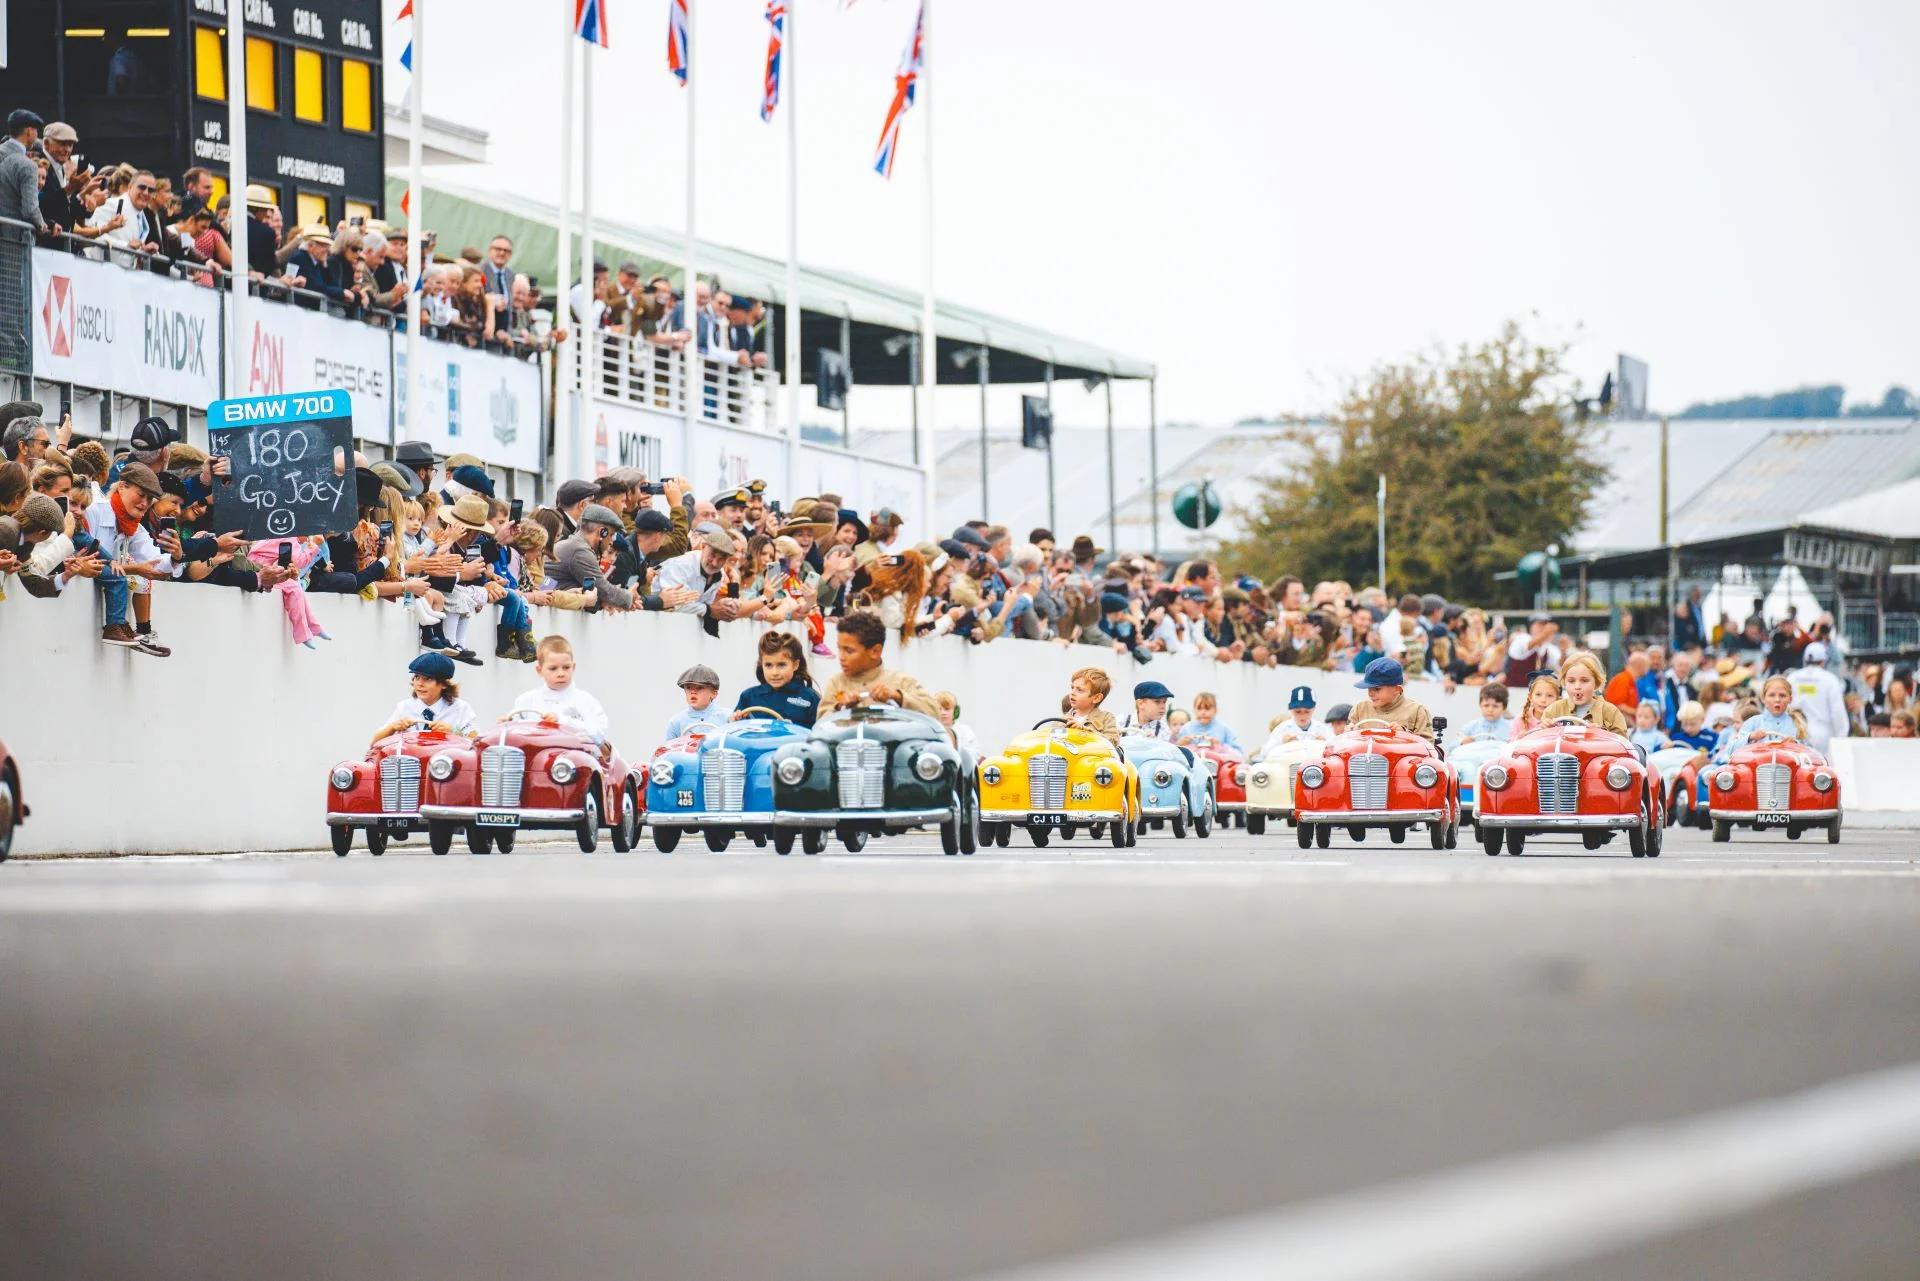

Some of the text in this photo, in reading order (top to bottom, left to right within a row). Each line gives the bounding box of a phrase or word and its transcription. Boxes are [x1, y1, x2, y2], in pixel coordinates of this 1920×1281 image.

[293, 8, 311, 36] CAR
[341, 19, 358, 47] CAR
[204, 121, 222, 140] LAPS
[277, 155, 295, 177] LAPS
[319, 164, 345, 186] LEADER
[77, 304, 101, 342] HSBC
[145, 304, 205, 376] RANDOX
[250, 320, 284, 395] AON
[224, 396, 334, 421] BMW 700
[248, 428, 308, 467] 180
[677, 790, 693, 799] TVC
[677, 798, 694, 807] 405
[480, 814, 517, 824] WOSPY
[1033, 815, 1045, 823] CJ
[1049, 815, 1061, 823] 18
[1757, 814, 1790, 823] MADC1
